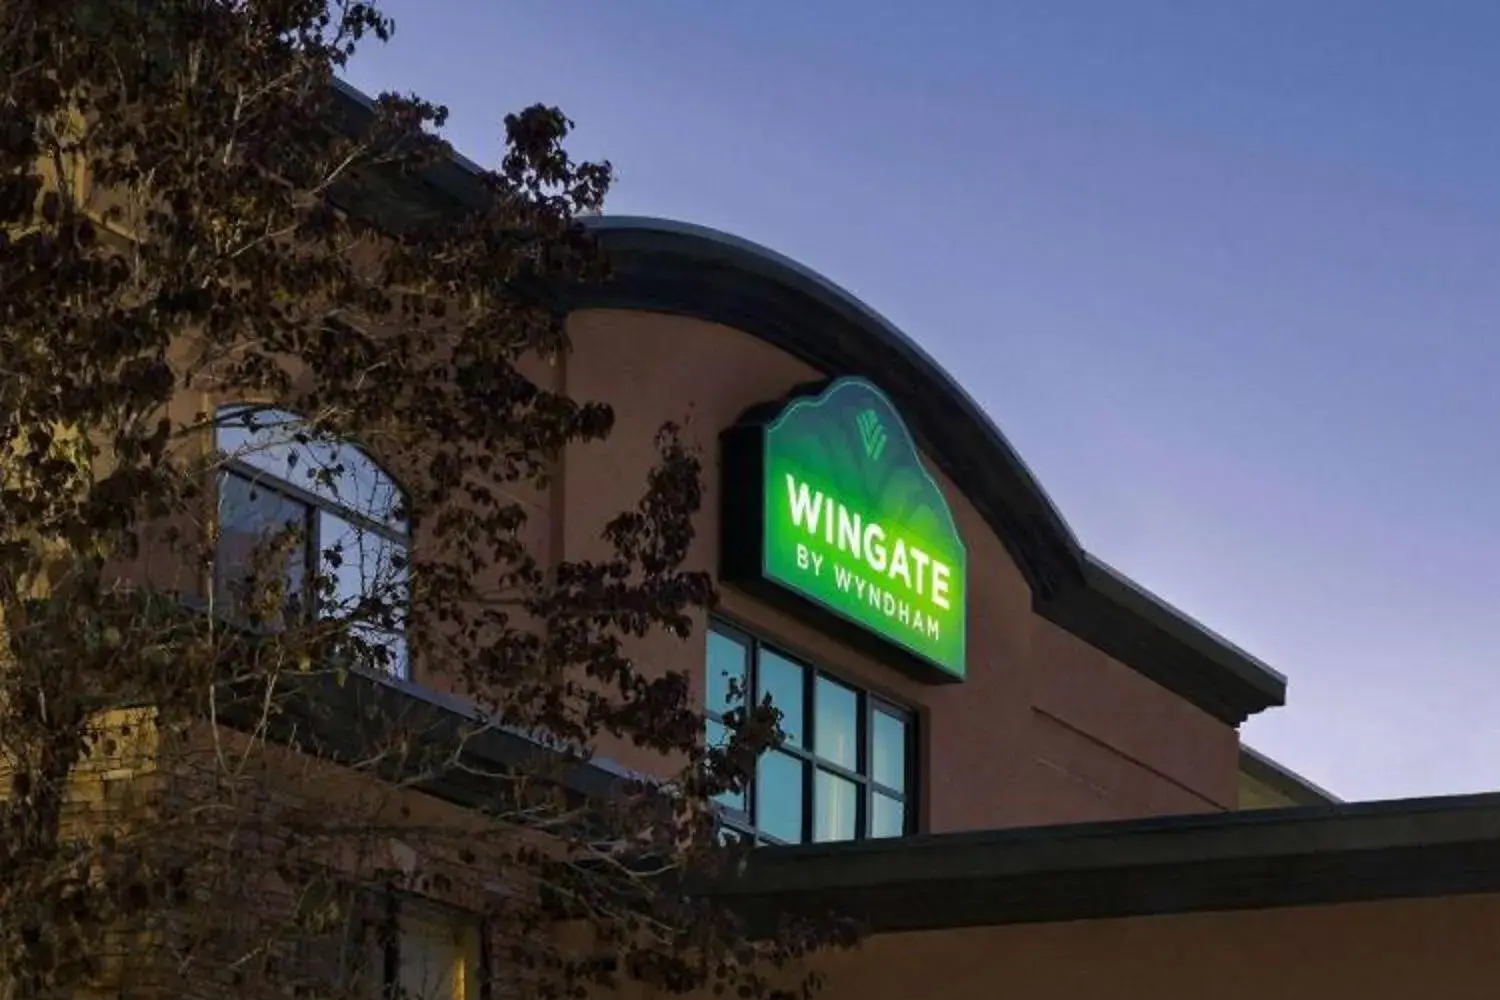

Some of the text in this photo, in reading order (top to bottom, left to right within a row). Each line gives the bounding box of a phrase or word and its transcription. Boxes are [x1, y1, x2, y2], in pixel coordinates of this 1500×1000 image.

[786, 474, 950, 610] WINGATE
[797, 544, 939, 640] BY WYNDHAM
